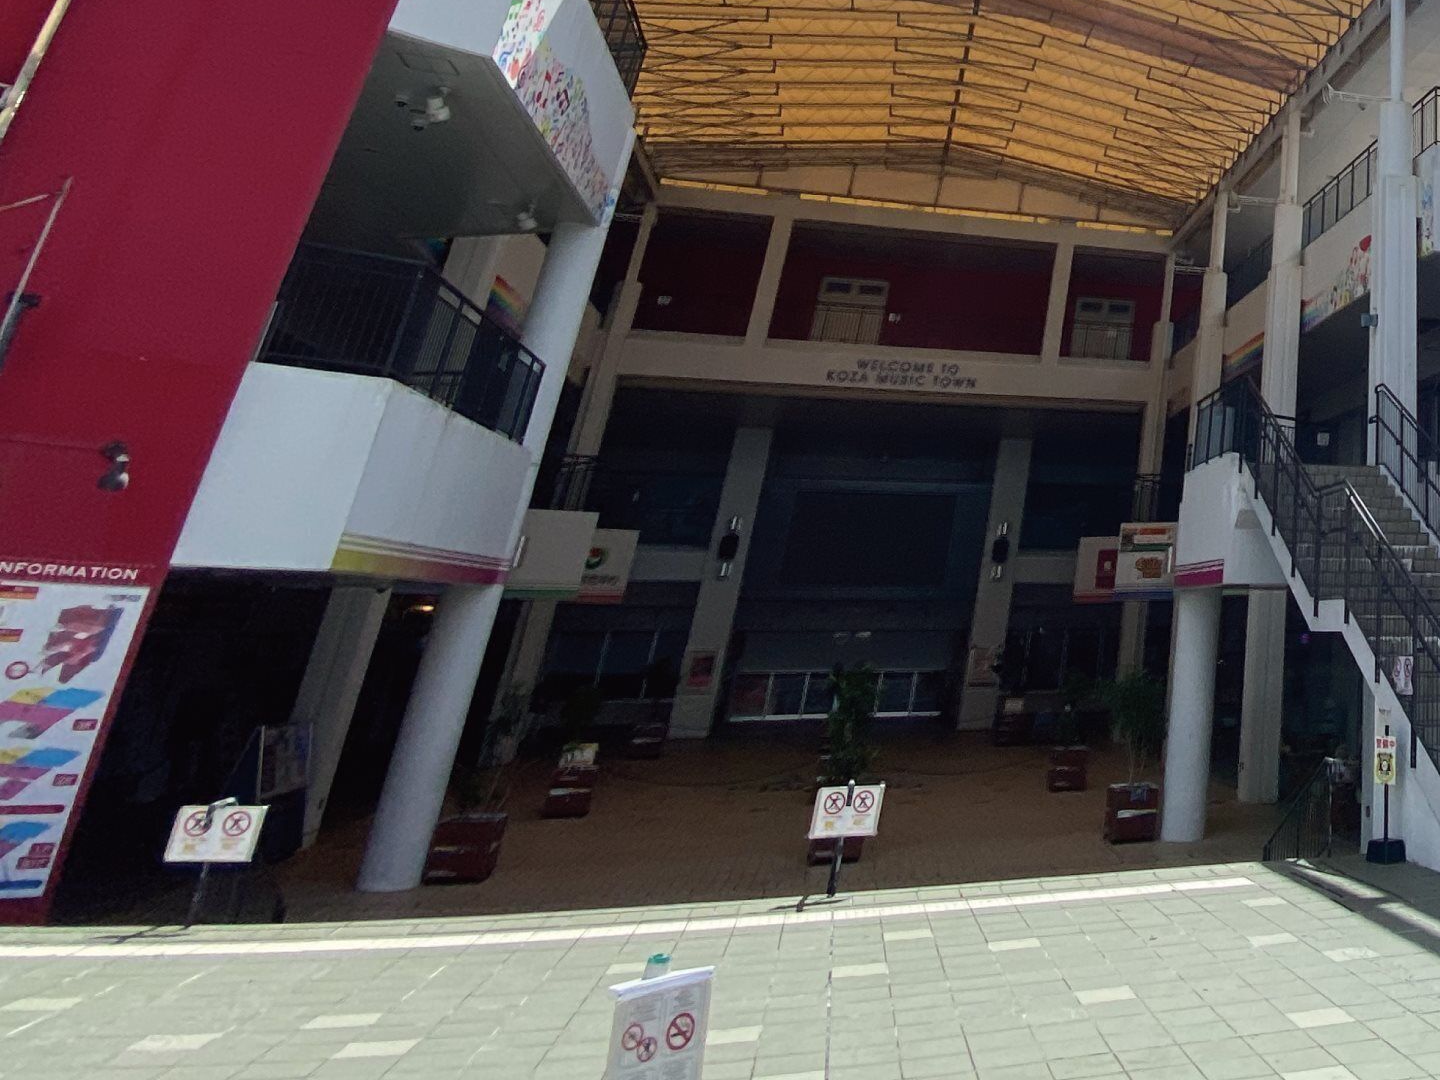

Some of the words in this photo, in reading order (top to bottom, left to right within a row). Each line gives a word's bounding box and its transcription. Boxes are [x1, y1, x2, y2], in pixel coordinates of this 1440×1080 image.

[857, 359, 935, 373] WELCOME
[942, 363, 960, 375] TO
[825, 369, 868, 383] KOZA
[876, 373, 926, 386] MUSIC
[933, 375, 977, 389] TOWN
